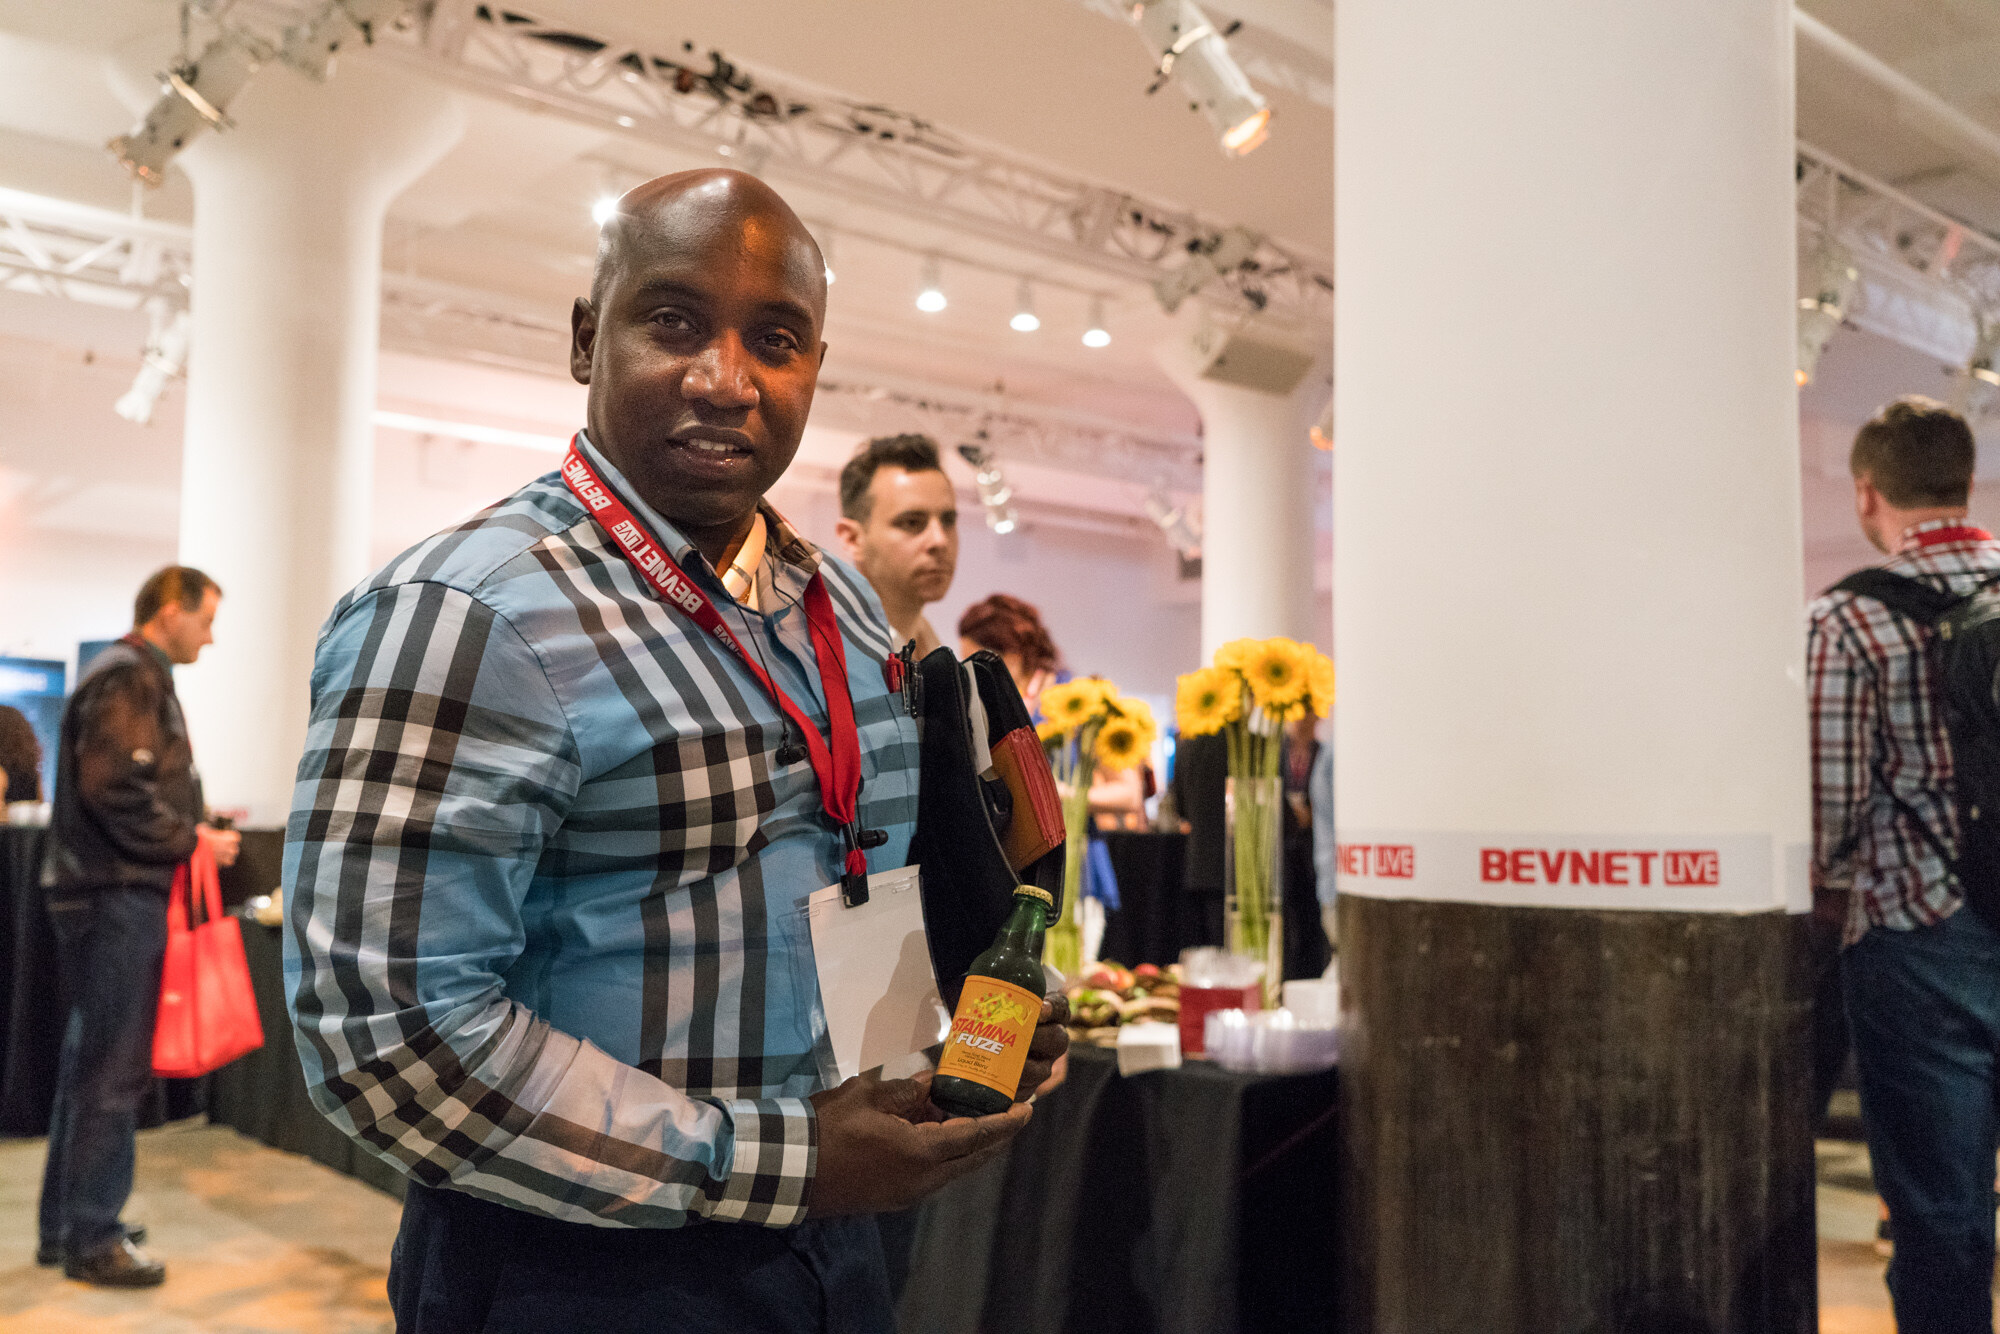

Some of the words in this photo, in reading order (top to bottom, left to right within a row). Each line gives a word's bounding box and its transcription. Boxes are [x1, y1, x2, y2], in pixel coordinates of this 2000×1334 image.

[611, 519, 645, 551] LIVE
[630, 543, 704, 613] BEVNET
[713, 624, 740, 653] LIVE
[1374, 845, 1414, 878] LIVE
[1481, 848, 1658, 886] BEVNET
[1663, 850, 1719, 886] LIVE
[952, 1018, 1017, 1047] STAMINA
[956, 1032, 1005, 1055] FUZE
